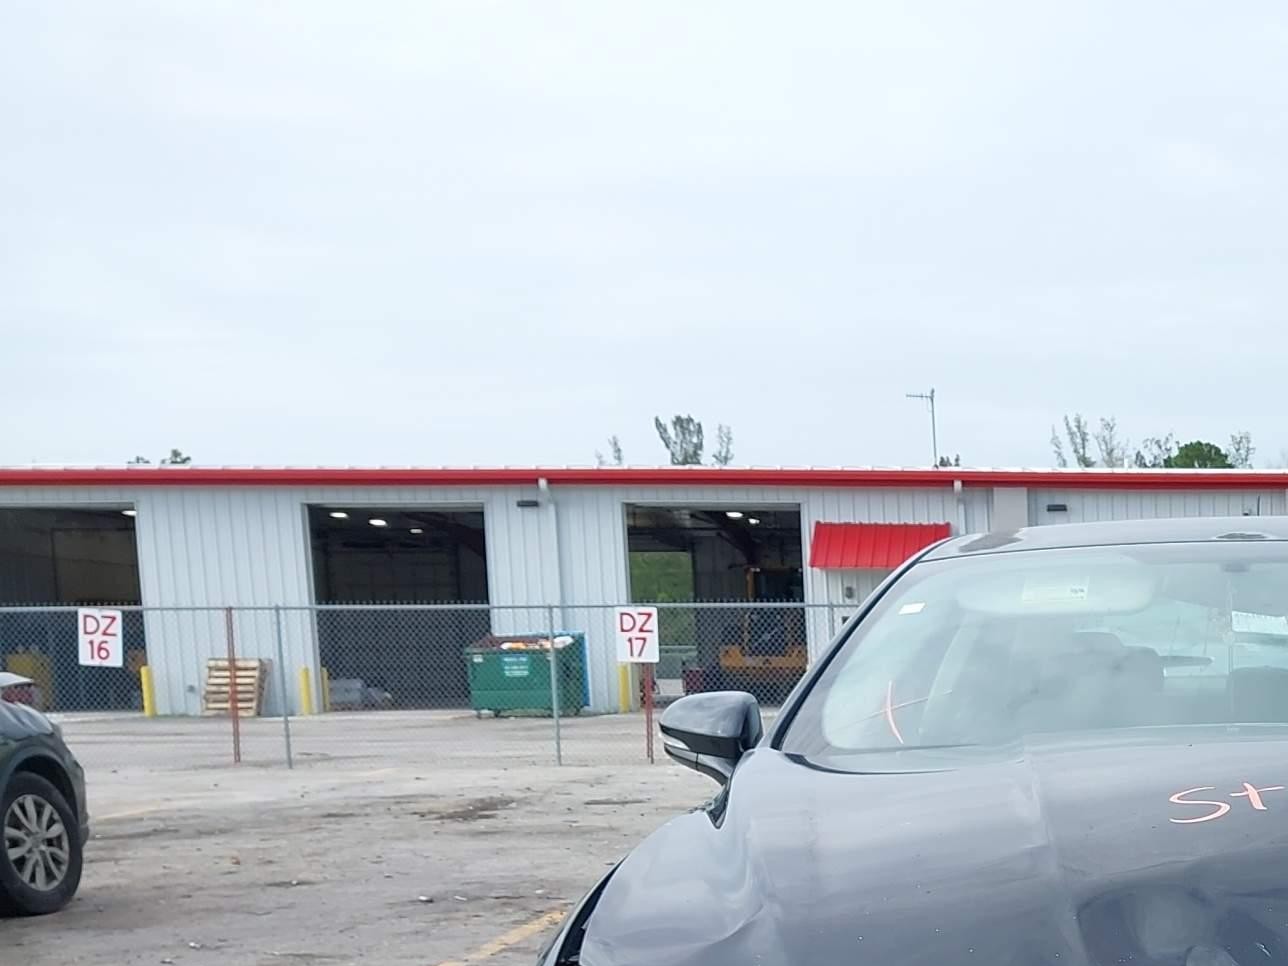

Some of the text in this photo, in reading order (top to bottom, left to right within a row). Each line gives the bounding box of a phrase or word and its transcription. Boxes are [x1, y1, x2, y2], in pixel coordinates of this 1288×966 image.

[83, 614, 118, 637] DZ
[620, 612, 654, 633] DZ
[88, 639, 110, 660] 16
[627, 637, 647, 657] 17
